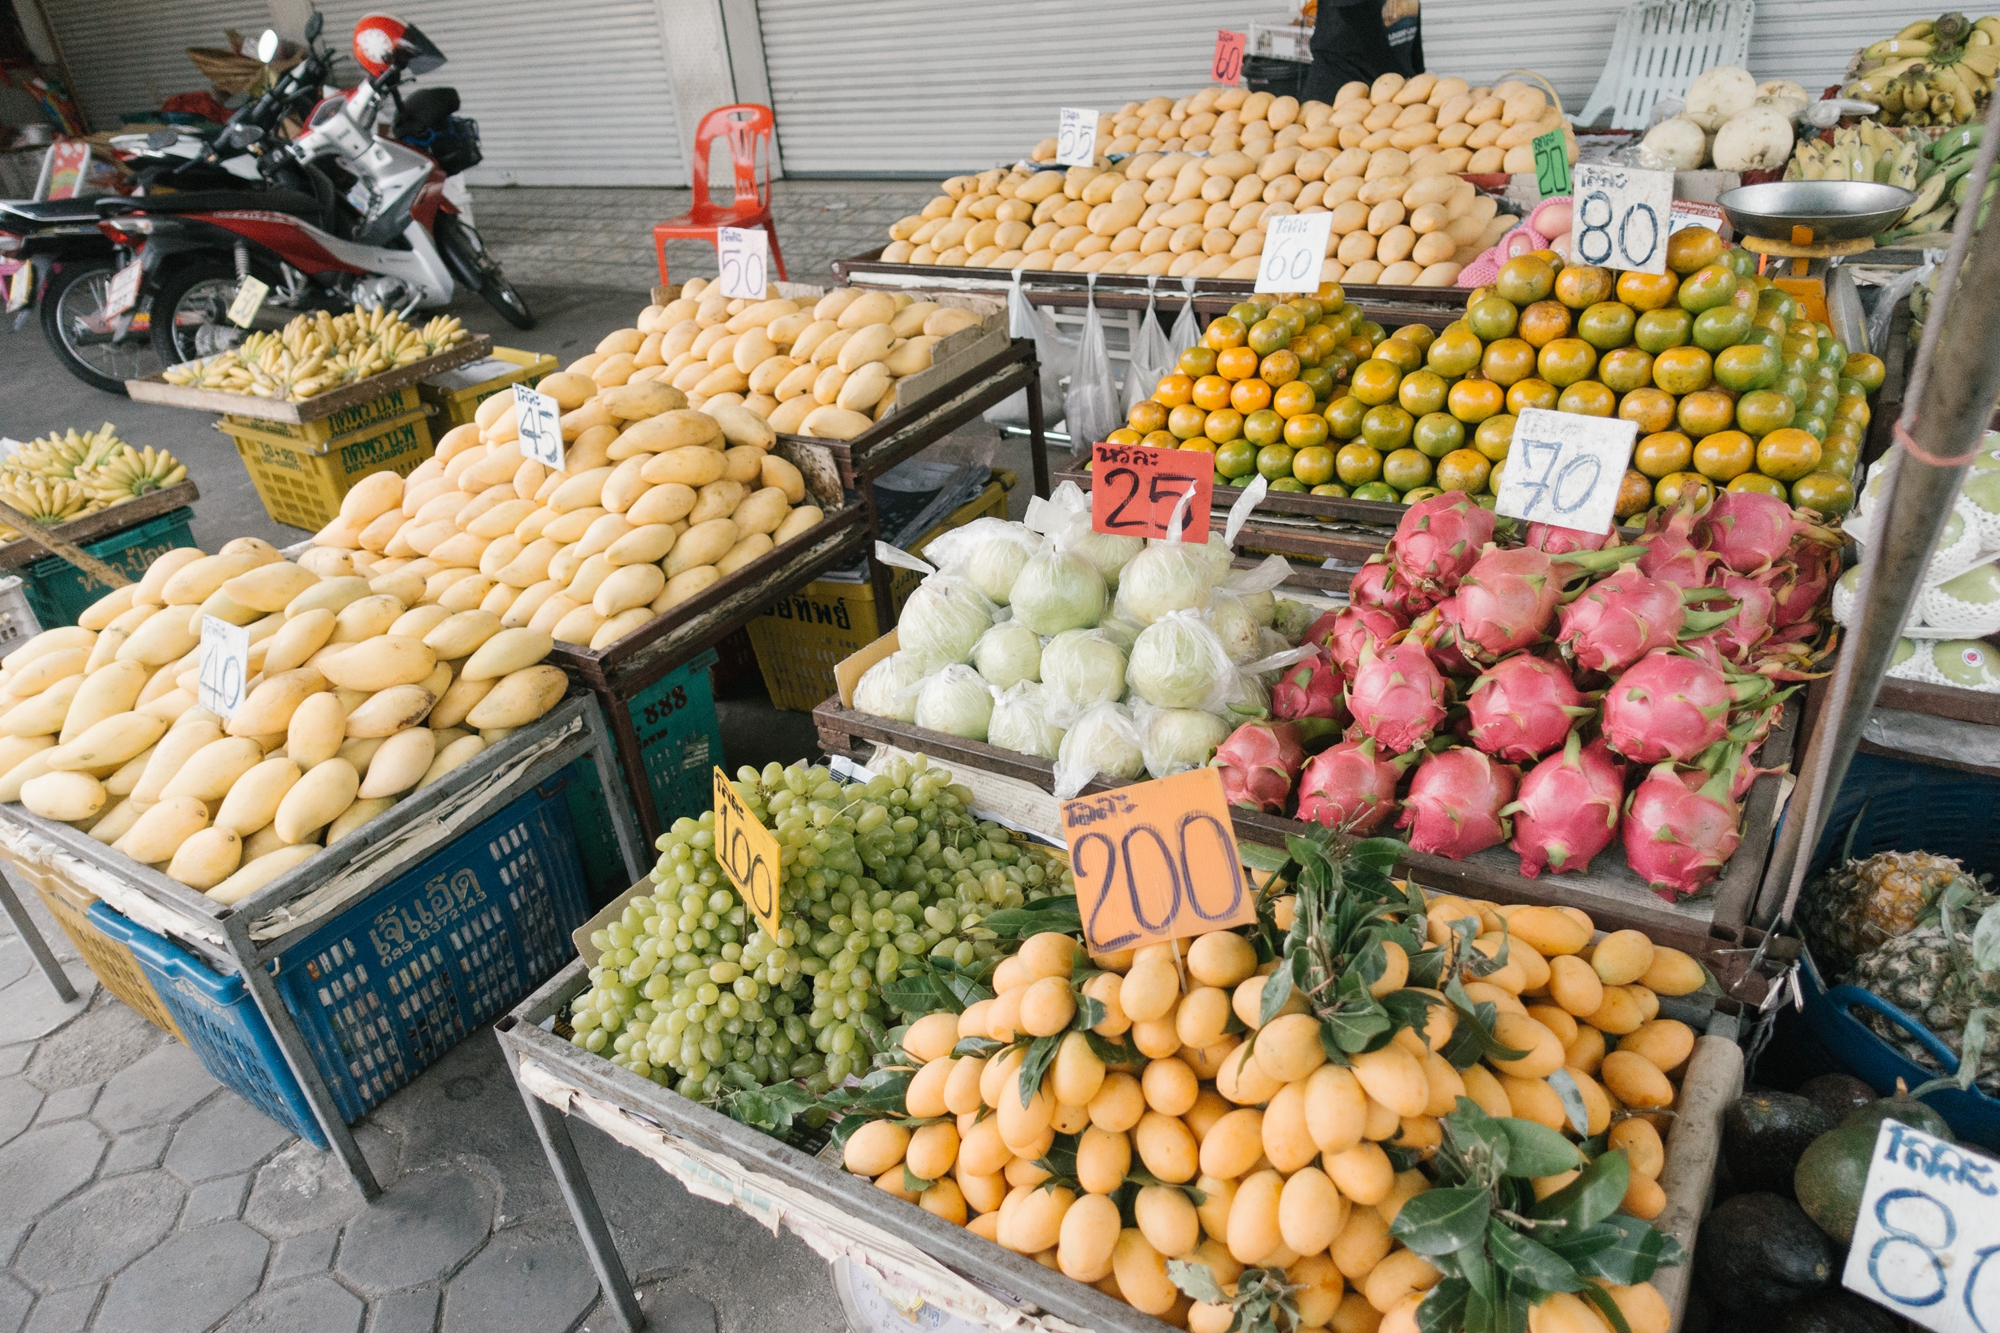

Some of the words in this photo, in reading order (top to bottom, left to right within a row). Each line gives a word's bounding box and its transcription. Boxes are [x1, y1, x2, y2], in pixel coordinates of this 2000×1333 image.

[1216, 44, 1240, 80] 60
[1061, 123, 1094, 160] 55
[1266, 237, 1312, 281] 60
[1578, 190, 1658, 266] 80
[722, 249, 763, 296] 50
[520, 406, 558, 463] 45
[1096, 445, 1159, 466] หัวละ
[1104, 467, 1199, 532] 25
[1516, 438, 1602, 517] 70
[199, 643, 241, 710] 40
[719, 803, 773, 919] 100
[1072, 810, 1243, 953] 200
[380, 890, 488, 968] 089-8372143
